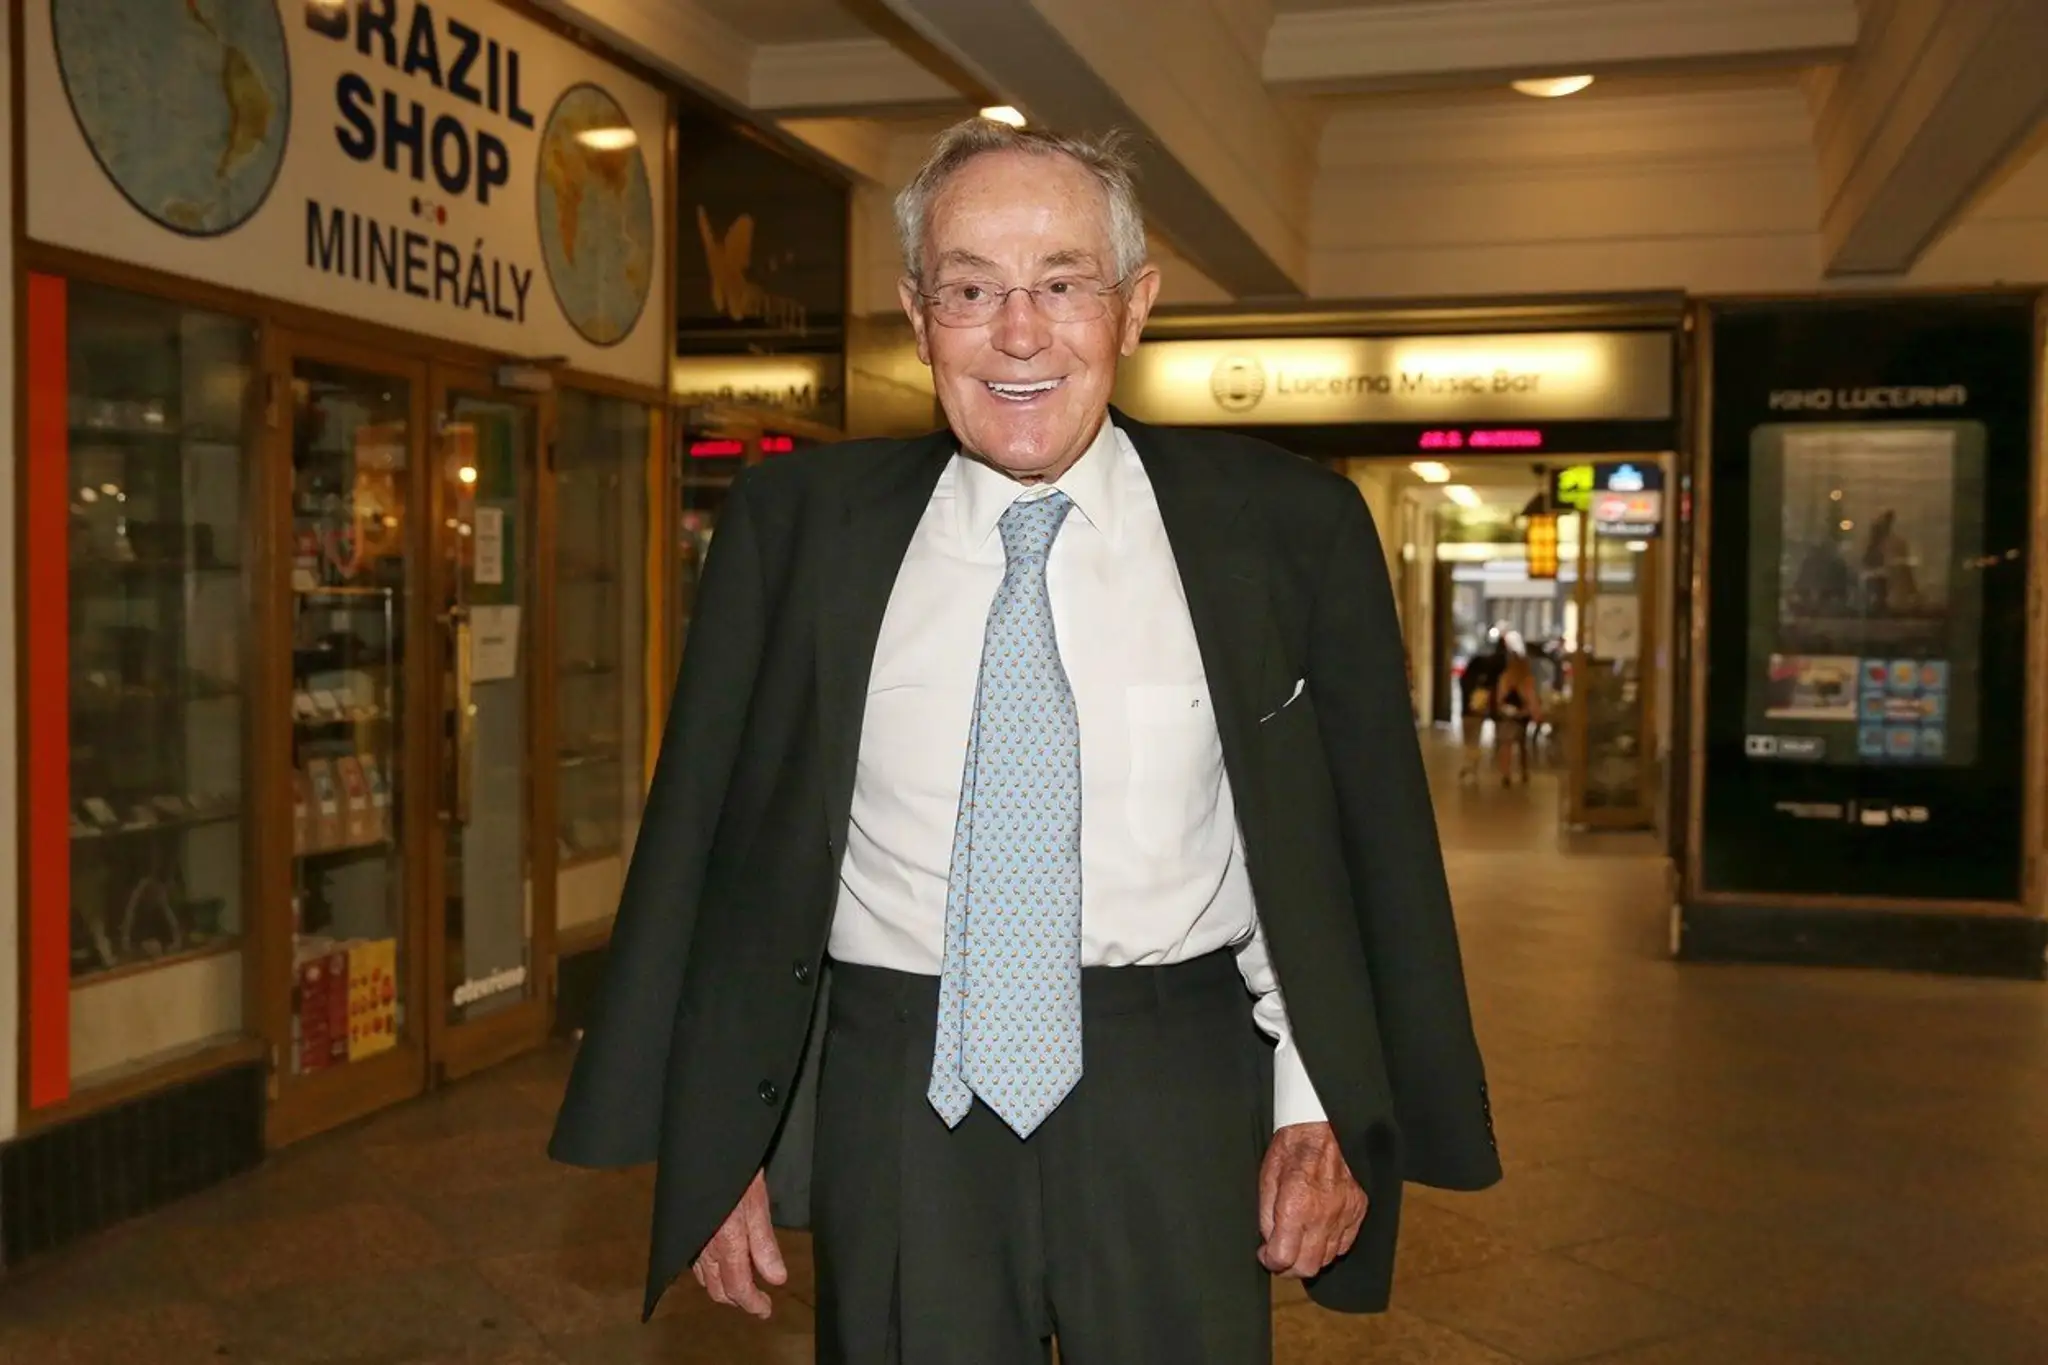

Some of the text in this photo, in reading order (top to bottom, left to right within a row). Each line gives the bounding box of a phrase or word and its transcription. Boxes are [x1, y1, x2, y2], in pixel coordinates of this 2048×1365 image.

[334, 72, 509, 206] SHOP
[306, 198, 532, 325] MINERÁLY
[1277, 369, 1543, 394] Lucerna Music Bar
[1768, 384, 1968, 410] KINO LUCERNA
